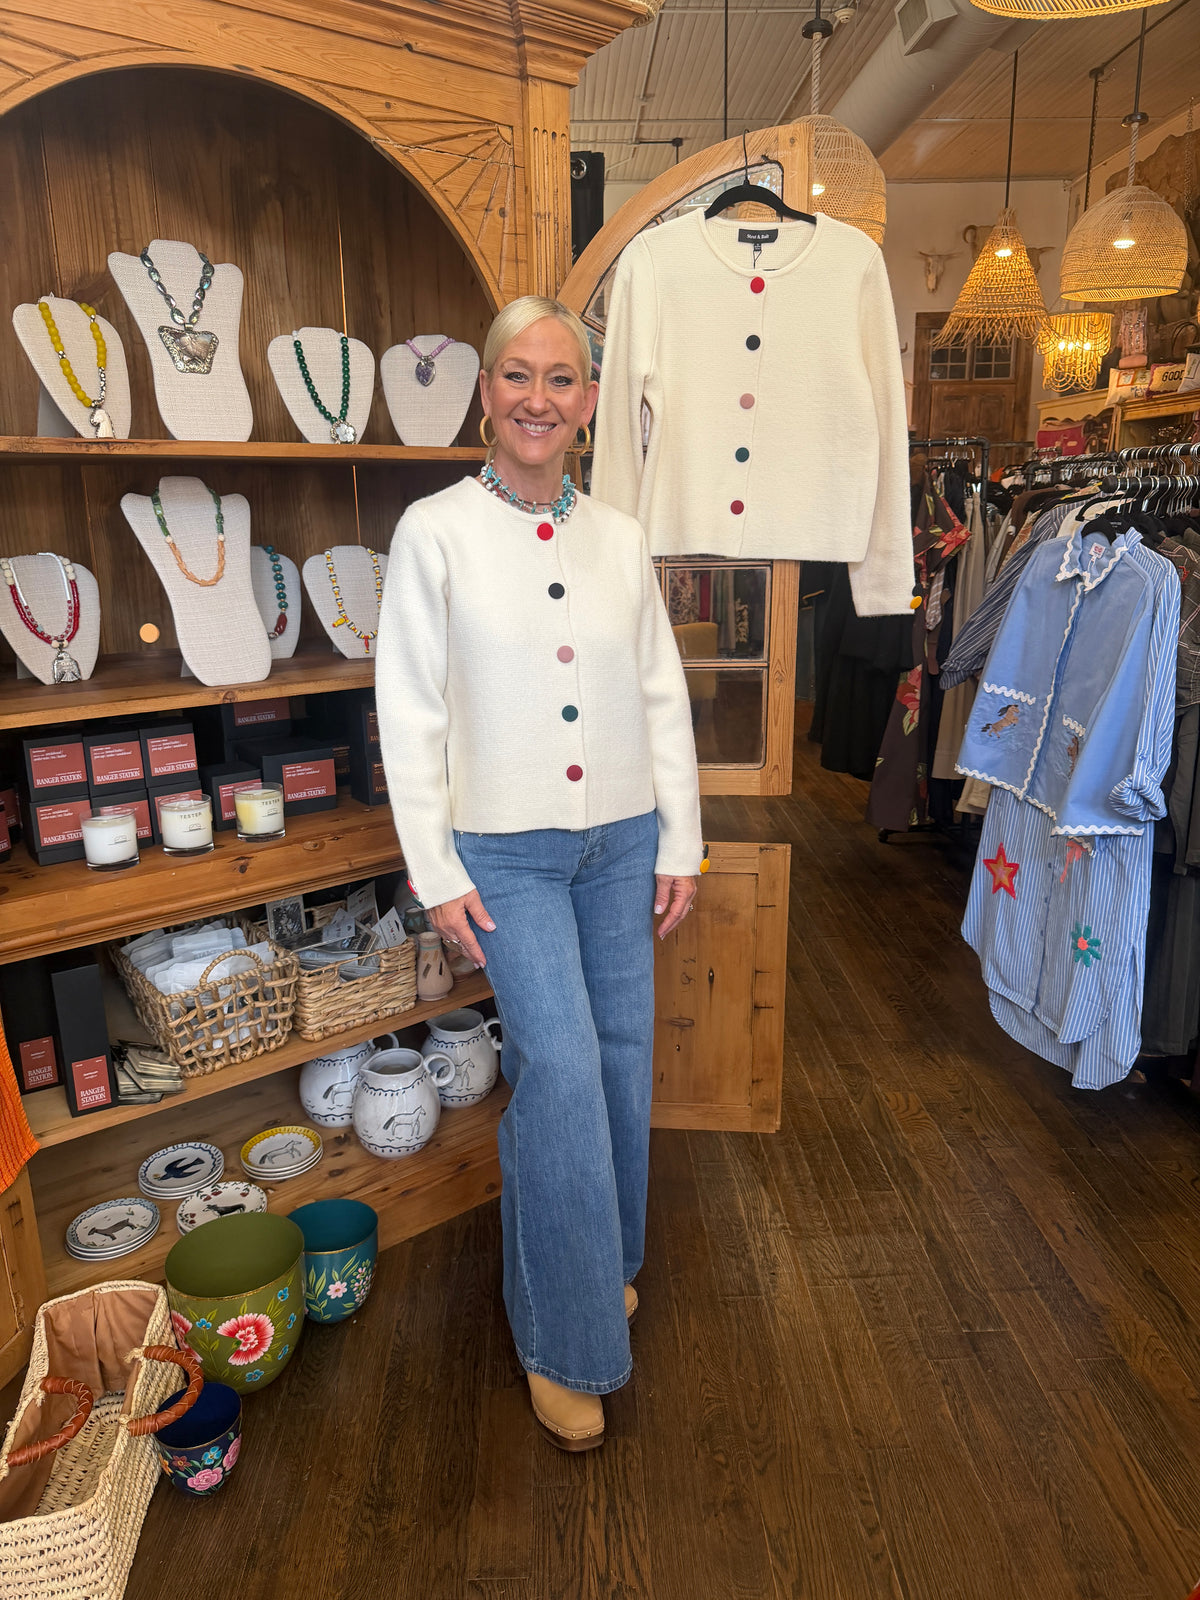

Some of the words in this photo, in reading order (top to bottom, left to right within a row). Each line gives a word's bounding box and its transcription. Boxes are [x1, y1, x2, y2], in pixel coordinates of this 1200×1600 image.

[153, 763, 175, 774] RANGER
[175, 762, 197, 771] STATION
[36, 775, 62, 786] RANGER
[60, 773, 82, 782] STATION
[96, 772, 119, 783] RANGER
[119, 770, 140, 780] STATION
[287, 790, 308, 800] RANGER
[307, 788, 326, 797] STATION
[180, 811, 202, 820] TESTER
[43, 834, 67, 844] RANGER
[27, 1065, 53, 1077] RANGER
[28, 1072, 53, 1083] STATION
[80, 1085, 106, 1098] RANGER
[81, 1092, 106, 1104] STATION
